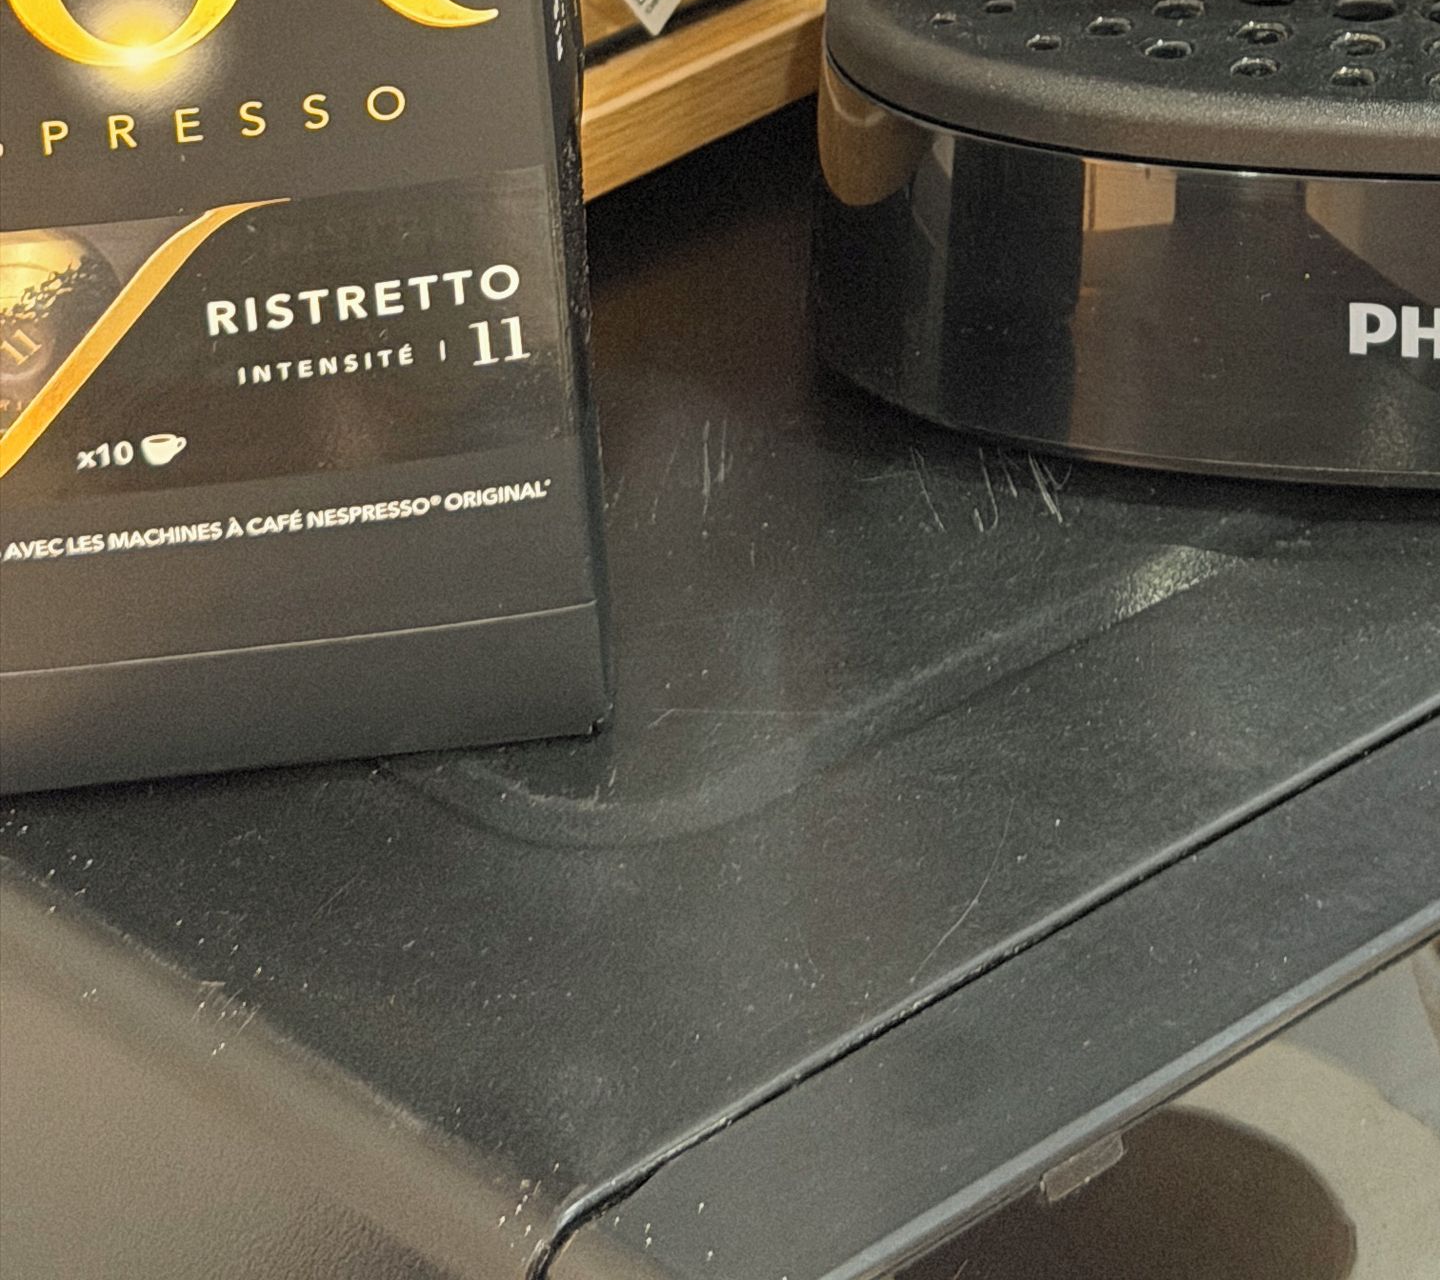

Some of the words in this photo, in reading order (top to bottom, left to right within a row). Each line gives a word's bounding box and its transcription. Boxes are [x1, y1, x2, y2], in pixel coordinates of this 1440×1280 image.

[0, 85, 406, 158] PRESSO
[206, 264, 520, 337] RISTRETTO
[237, 343, 414, 386] INTENSITÉ
[468, 316, 531, 366] 11
[76, 440, 134, 471] x10
[3, 536, 65, 562] AVEC
[65, 533, 105, 556] LES
[107, 520, 223, 552] MACHINES
[225, 516, 244, 539] À
[246, 509, 304, 538] CAFÉ
